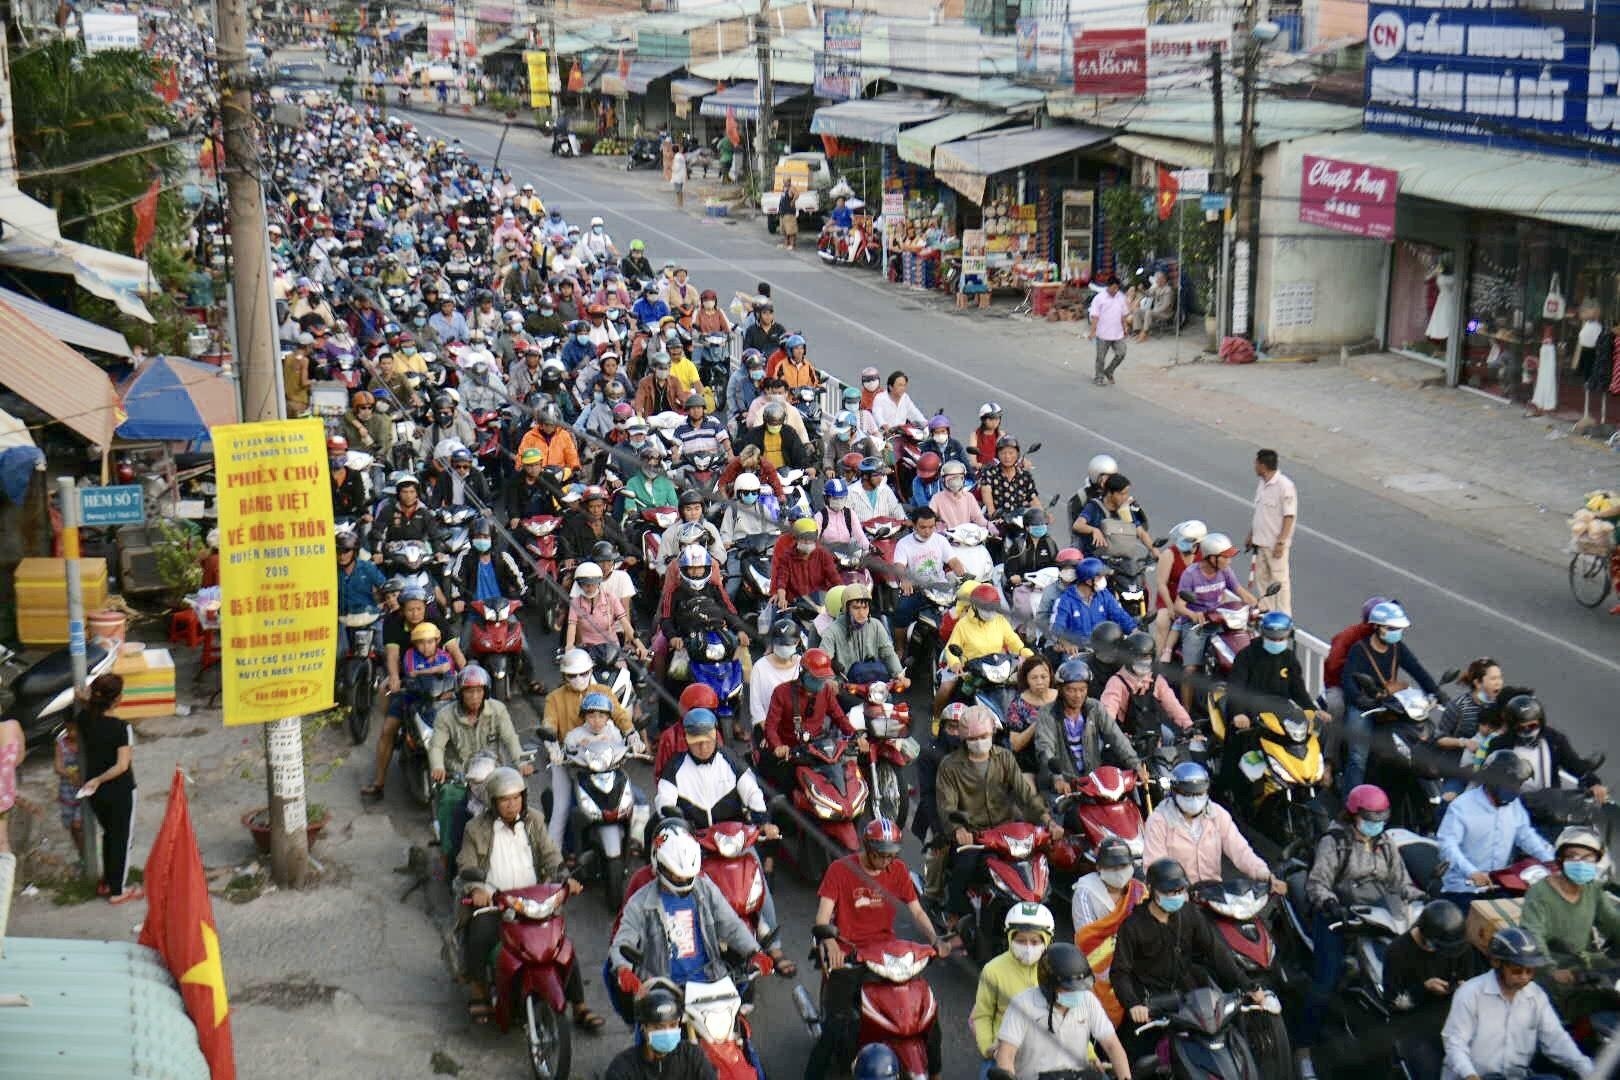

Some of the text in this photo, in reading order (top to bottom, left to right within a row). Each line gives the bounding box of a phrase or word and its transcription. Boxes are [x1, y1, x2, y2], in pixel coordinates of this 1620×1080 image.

[1374, 25, 1398, 48] CN
[283, 459, 320, 485] CHỢ
[278, 490, 308, 513] VIỆT
[249, 521, 285, 542] NÔNG
[290, 517, 327, 538] THÔN
[265, 566, 289, 578] 2019
